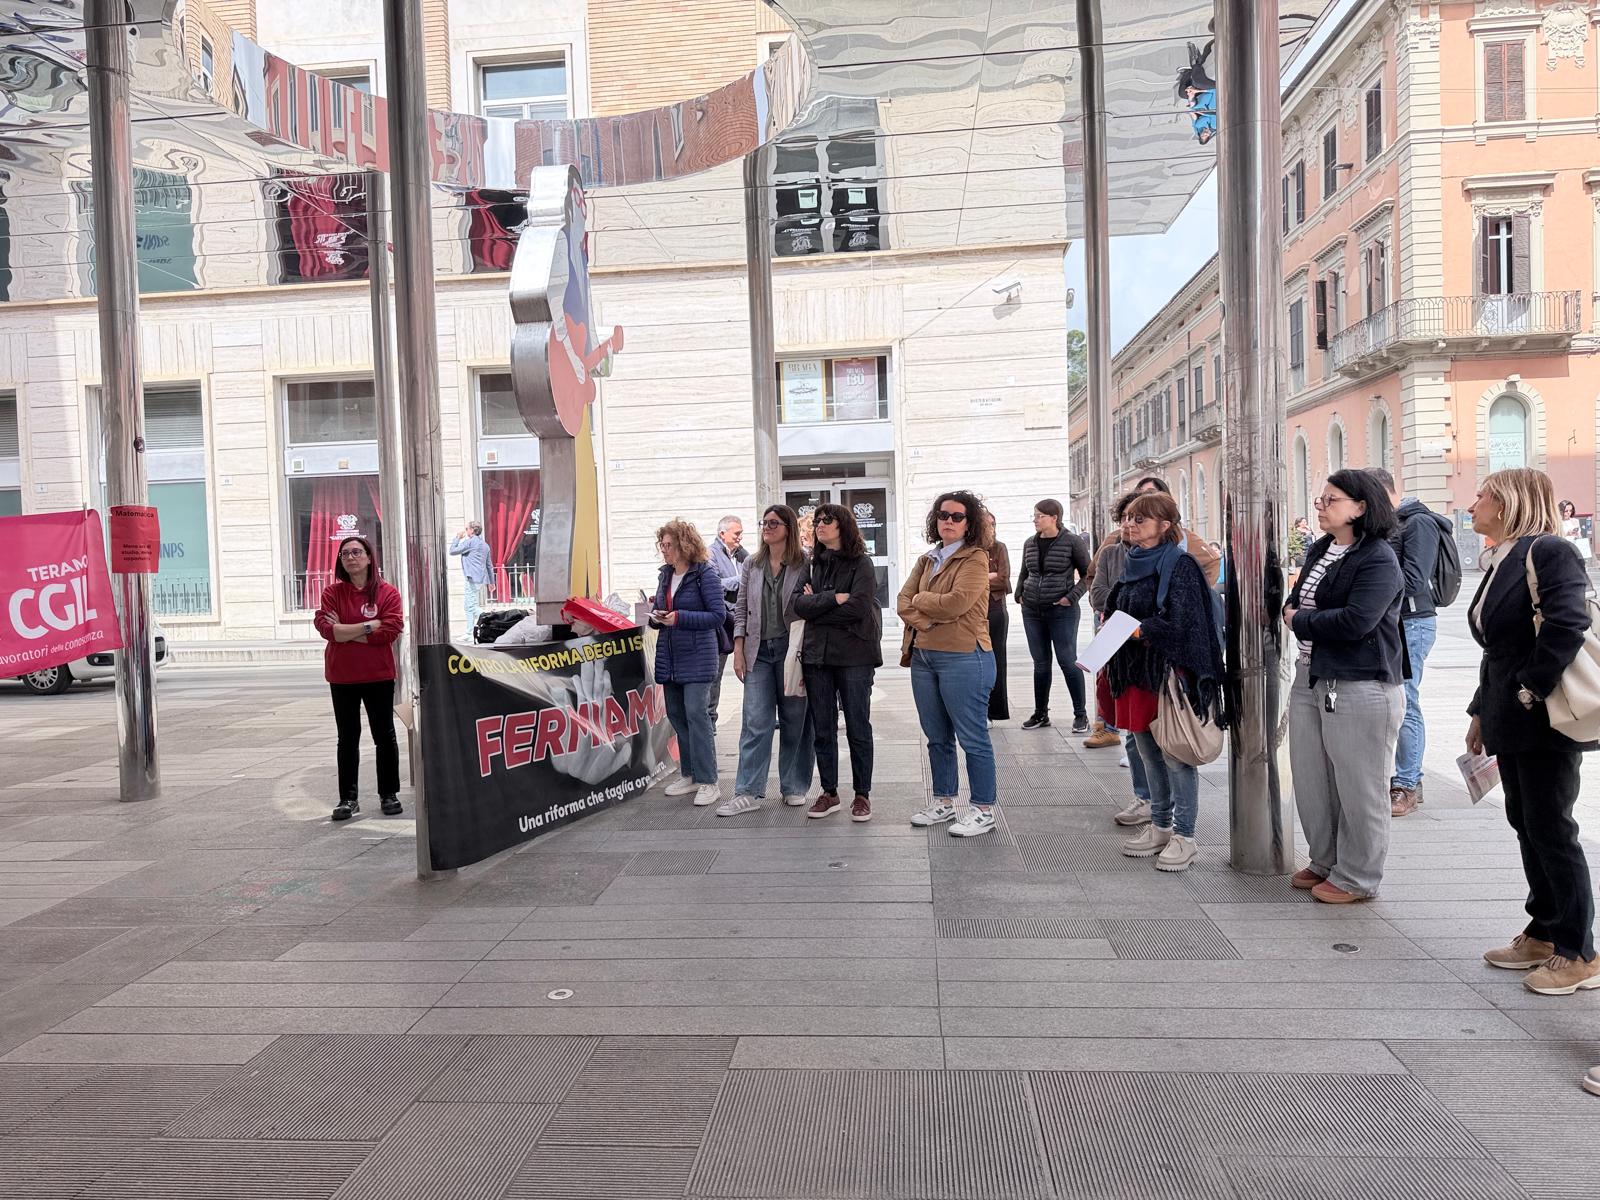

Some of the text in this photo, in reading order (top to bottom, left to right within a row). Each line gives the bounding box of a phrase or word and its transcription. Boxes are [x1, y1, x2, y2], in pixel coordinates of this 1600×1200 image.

[8, 574, 98, 640] CGIL
[447, 654, 504, 675] CONTRO
[518, 648, 584, 673] RIFORMA
[583, 638, 626, 662] DEGLI
[518, 813, 543, 833] Una
[544, 798, 585, 824] riforma
[586, 790, 605, 807] che
[605, 777, 635, 801] taglia
